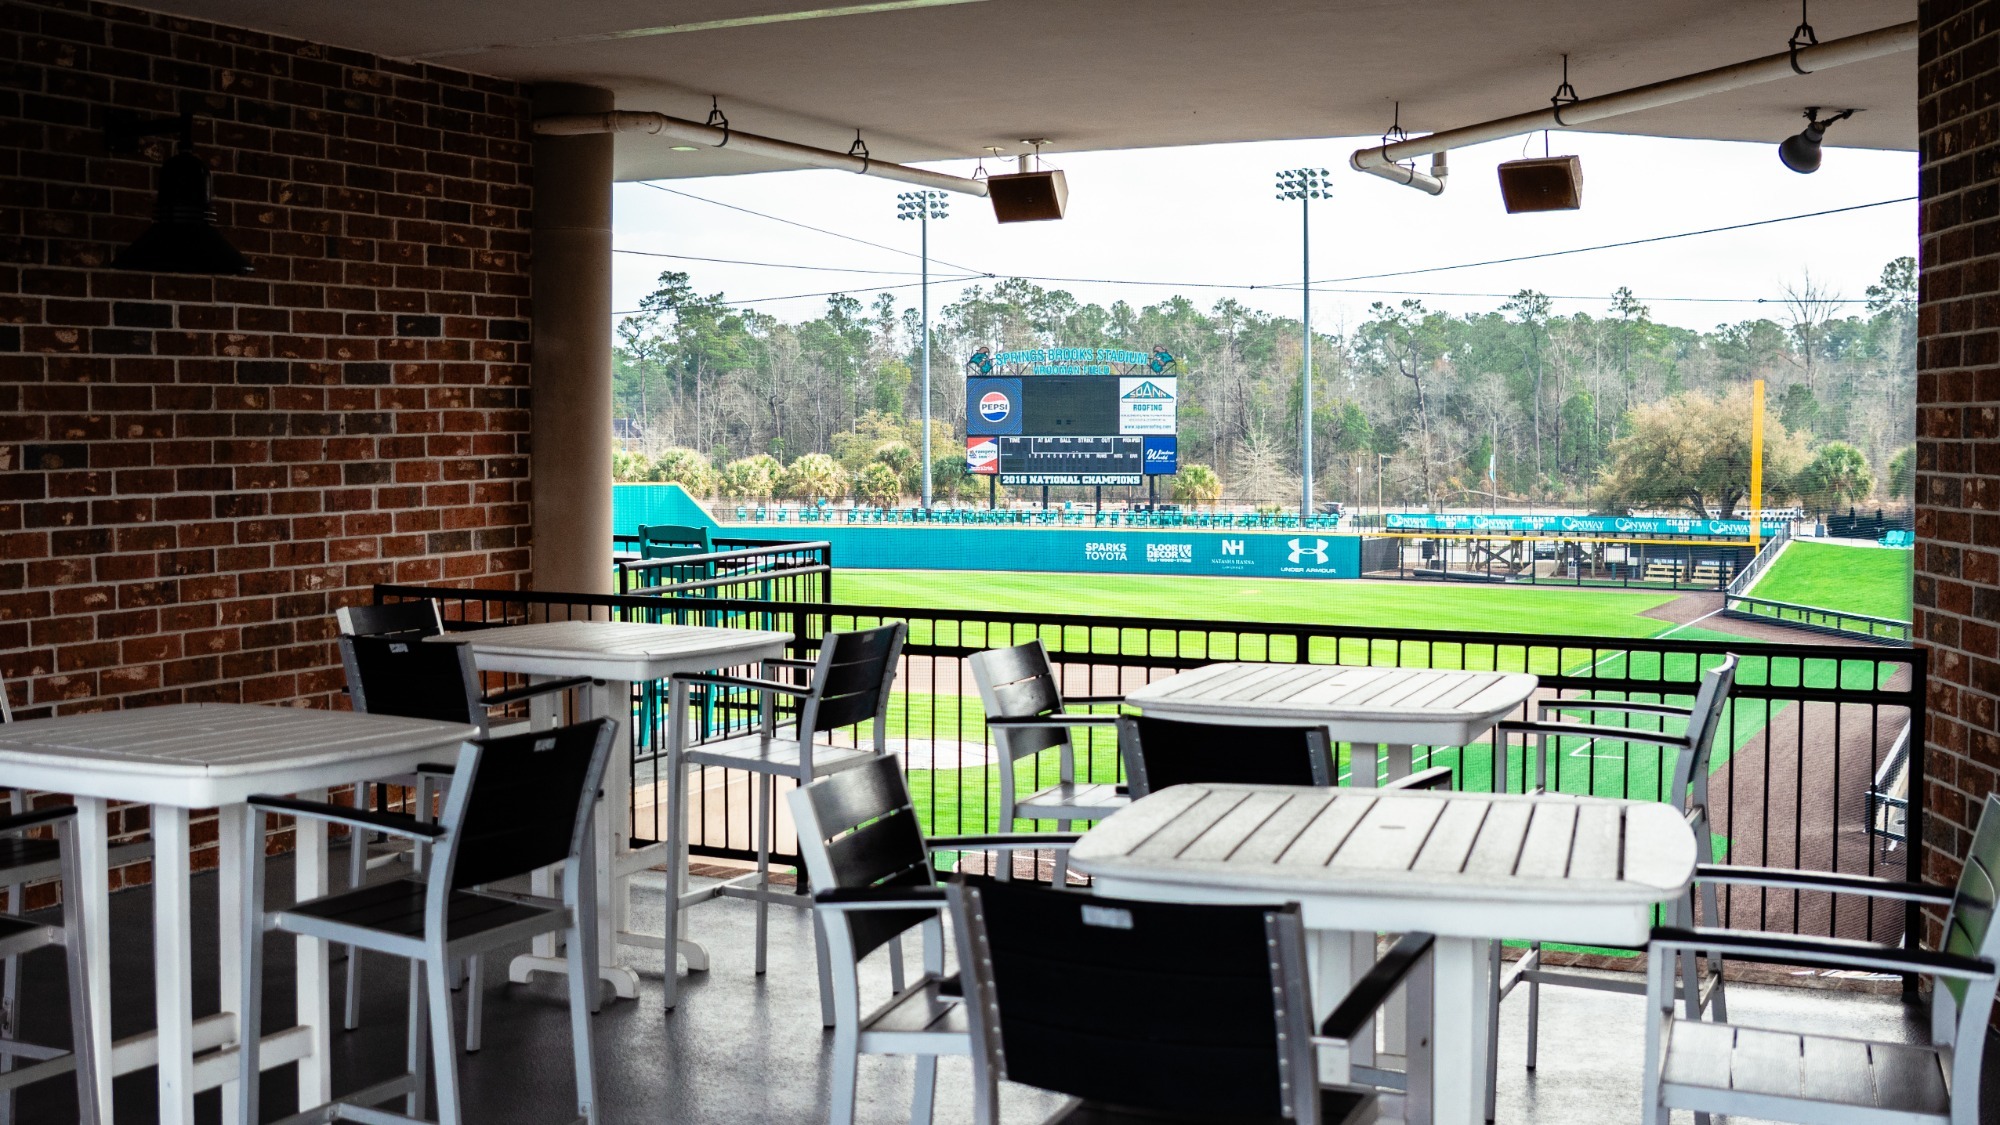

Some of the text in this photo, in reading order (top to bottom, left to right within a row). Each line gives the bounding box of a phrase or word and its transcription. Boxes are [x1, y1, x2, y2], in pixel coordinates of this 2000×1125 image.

[995, 348, 1148, 367] SPRINGS BROOKS STADIUM
[1082, 364, 1111, 375] FIELD
[1129, 383, 1167, 398] SPANN
[981, 403, 1008, 411] PEPSI
[1002, 475, 1140, 484] 2016 NATIONAL CHAMPIONS
[1562, 516, 1604, 530] CONWAY
[1615, 517, 1659, 531] CONWAY
[1086, 542, 1126, 552] SPARKS
[1222, 540, 1244, 556] NH
[1085, 552, 1128, 560] TOYOTA
